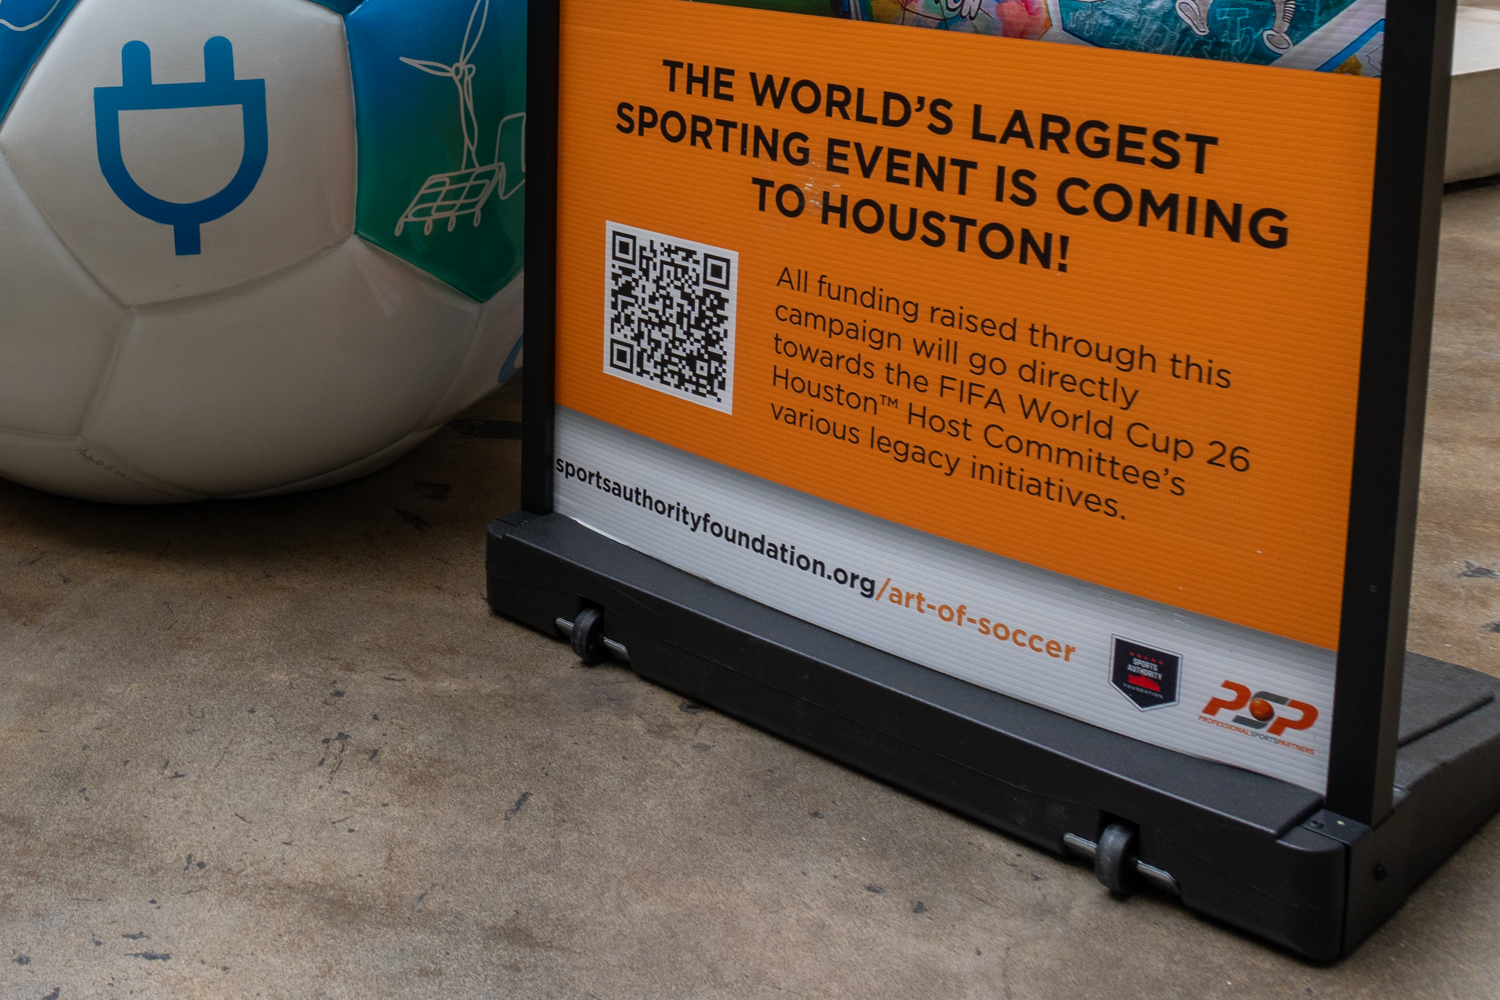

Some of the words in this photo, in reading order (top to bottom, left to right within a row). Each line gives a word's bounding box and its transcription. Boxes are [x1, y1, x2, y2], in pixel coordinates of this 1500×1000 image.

[661, 58, 735, 101] THE
[749, 71, 955, 135] WORLD'S
[972, 104, 1219, 175] LARGEST
[615, 102, 810, 166] SPORTING
[827, 137, 978, 196] EVENT
[995, 166, 1038, 208] IS
[1057, 177, 1290, 250] COMING
[751, 177, 803, 219] TO
[820, 191, 1071, 274] HOUSTON!
[774, 303, 902, 351] campaign
[913, 333, 958, 366] will
[969, 352, 1007, 376] go
[1018, 359, 1139, 411] directly
[776, 266, 808, 293] All
[818, 275, 919, 323] funding
[930, 304, 1017, 342] raised
[1029, 322, 1156, 373] through
[1170, 352, 1232, 389] this
[774, 333, 875, 379] towards
[885, 362, 929, 393] the
[940, 376, 1006, 414] FIFA
[1019, 394, 1113, 440] World
[1127, 422, 1194, 462] Cup
[1207, 440, 1251, 473] 26
[908, 402, 972, 441] Host
[983, 424, 1186, 497] Committee's
[770, 403, 859, 444] various
[870, 427, 960, 477] legacy
[971, 453, 1127, 520] initiatives.
[555, 456, 1076, 662] sportsauthorityfoundation.org/art-of-soccer
[1123, 683, 1164, 699] FOUNDATION
[1127, 664, 1163, 680] AUTHORITY
[1132, 657, 1158, 671] SPORTS
